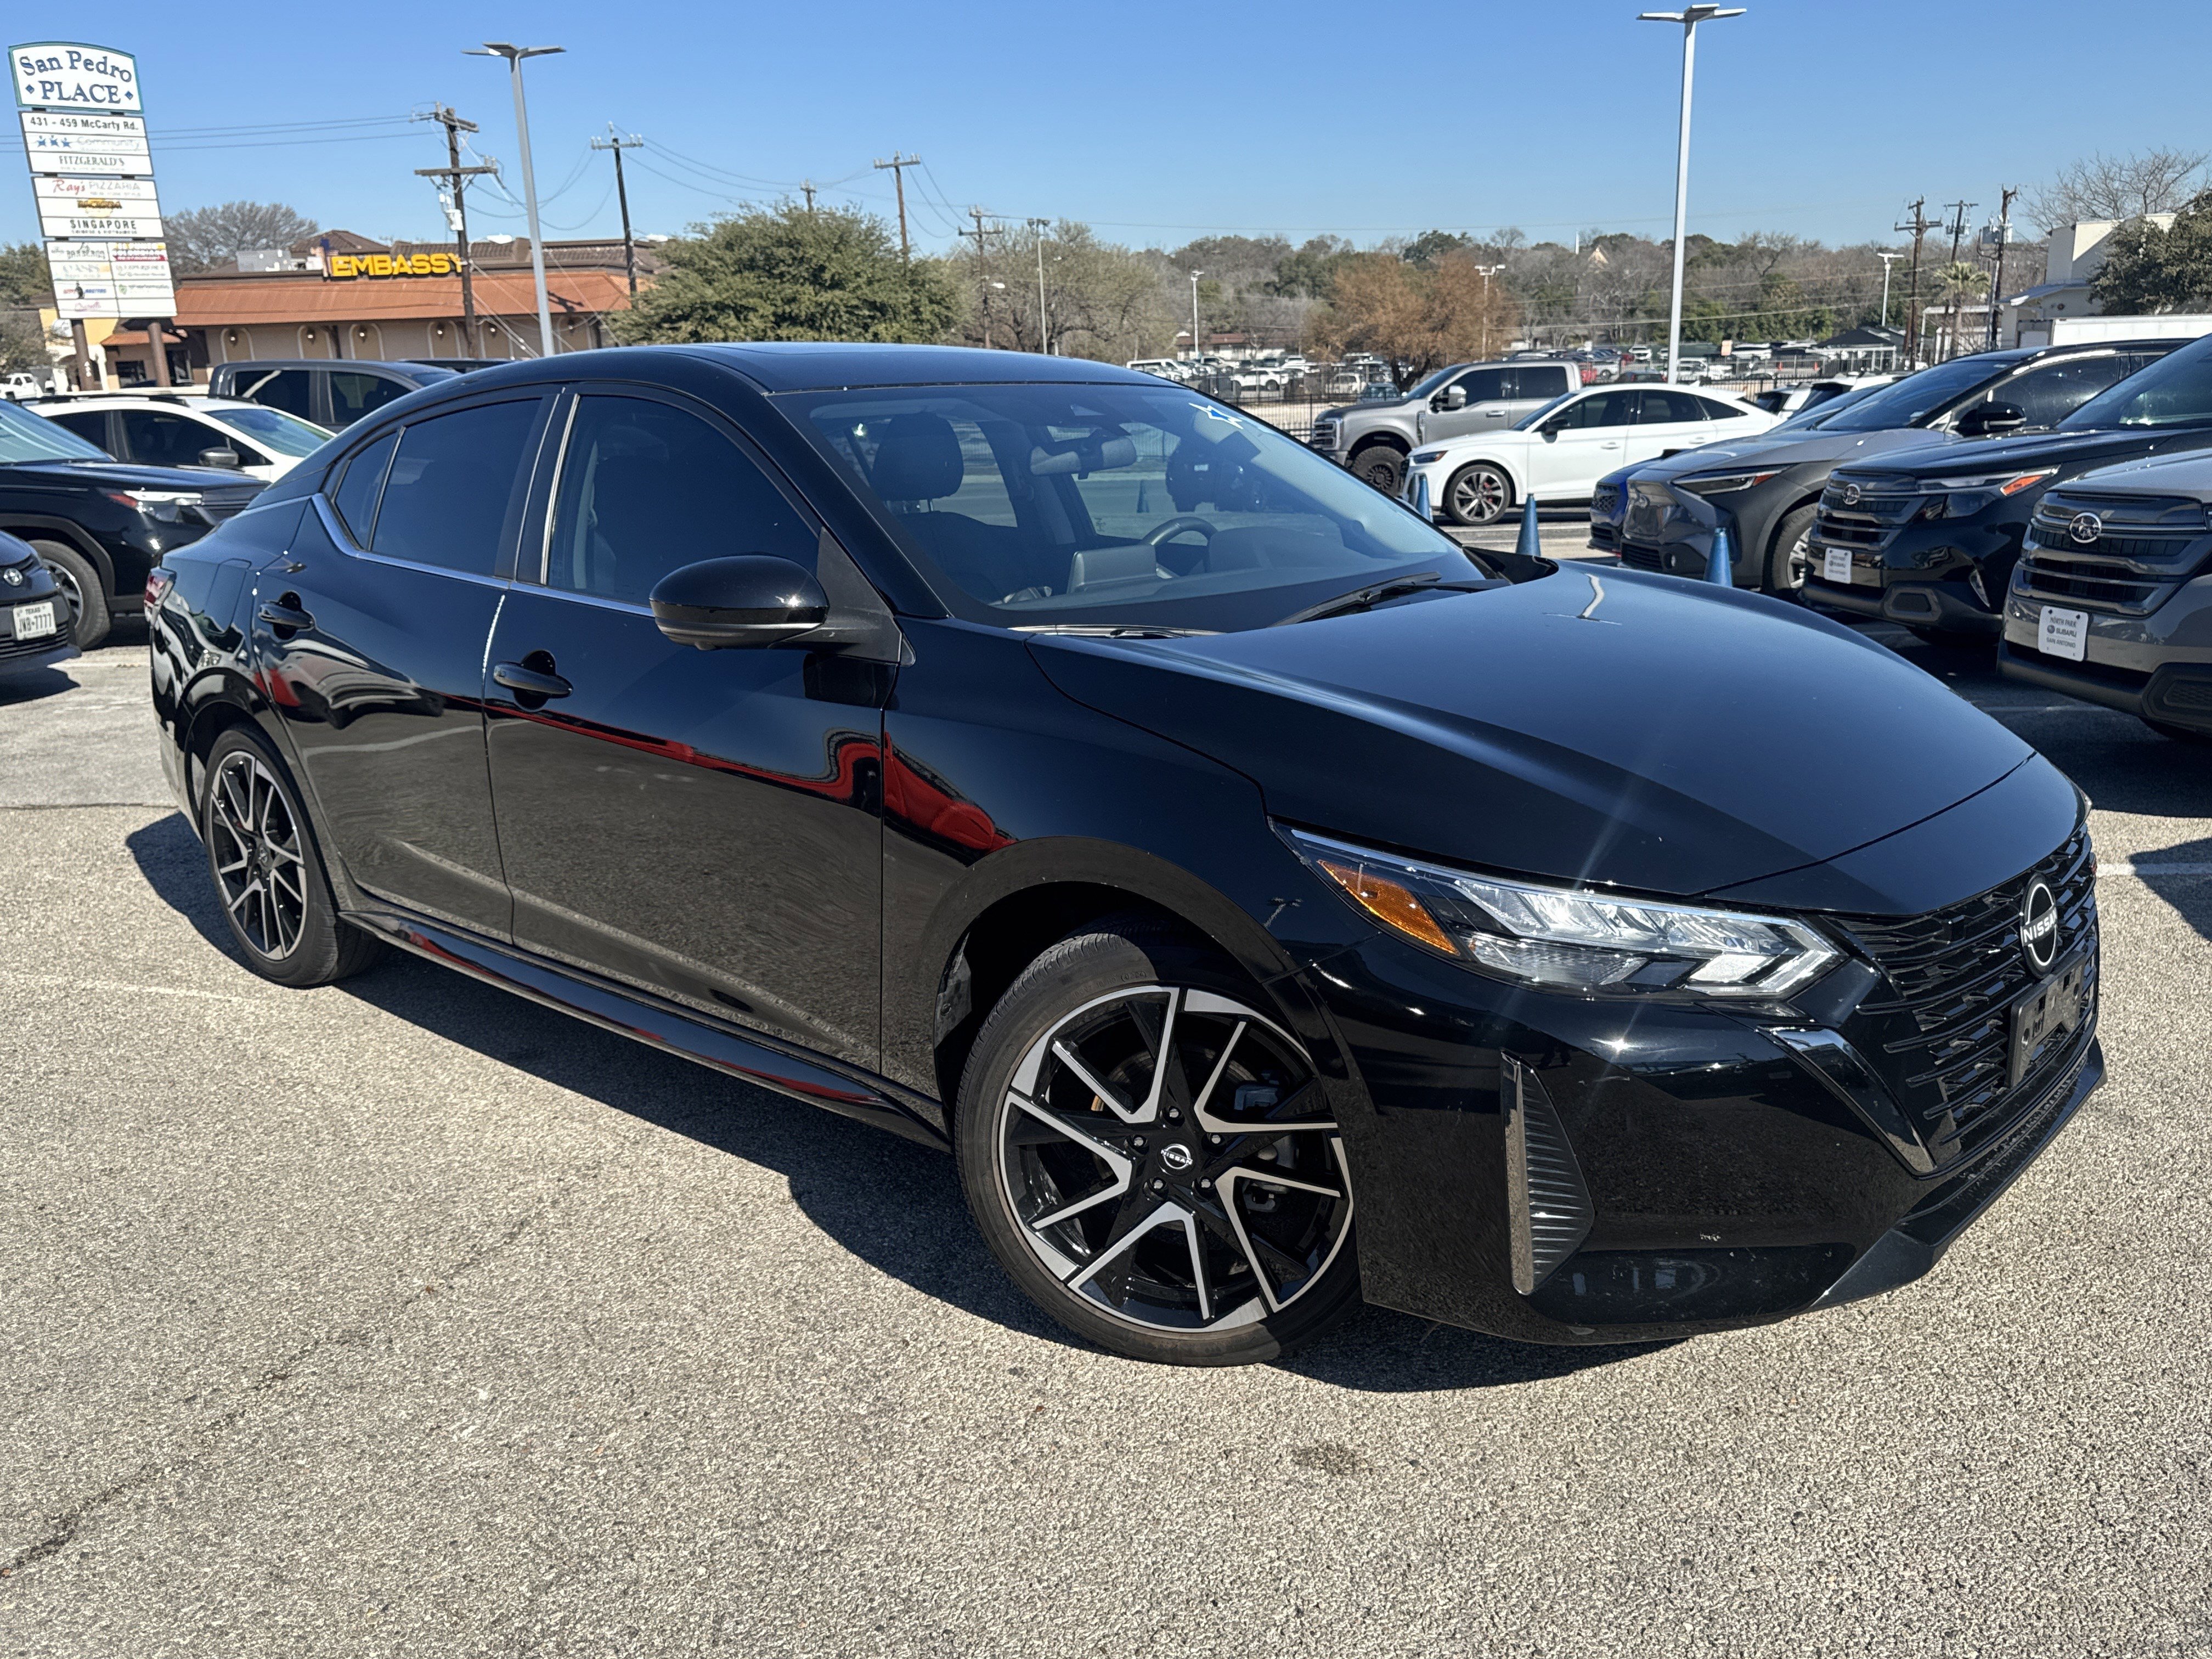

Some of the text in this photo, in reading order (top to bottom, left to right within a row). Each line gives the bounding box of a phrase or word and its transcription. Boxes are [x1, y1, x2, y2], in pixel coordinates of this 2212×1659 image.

[19, 50, 132, 82] San Pedro
[38, 81, 121, 104] PLACE
[30, 117, 47, 126] 431
[60, 118, 77, 127] 459
[81, 119, 120, 131] McCarty
[123, 120, 139, 130] Rd.
[59, 155, 125, 166] FITZGERALD'S
[52, 178, 86, 195] Ray's
[70, 219, 137, 230] SINGAPORE
[331, 252, 463, 277] EMBASSY
[2050, 617, 2064, 625] NORTH
[2056, 627, 2077, 638] SUBARU
[2056, 640, 2076, 648] ANTONIO
[2023, 908, 2058, 943] NISSAN
[1160, 1149, 1193, 1165] NISSAN
